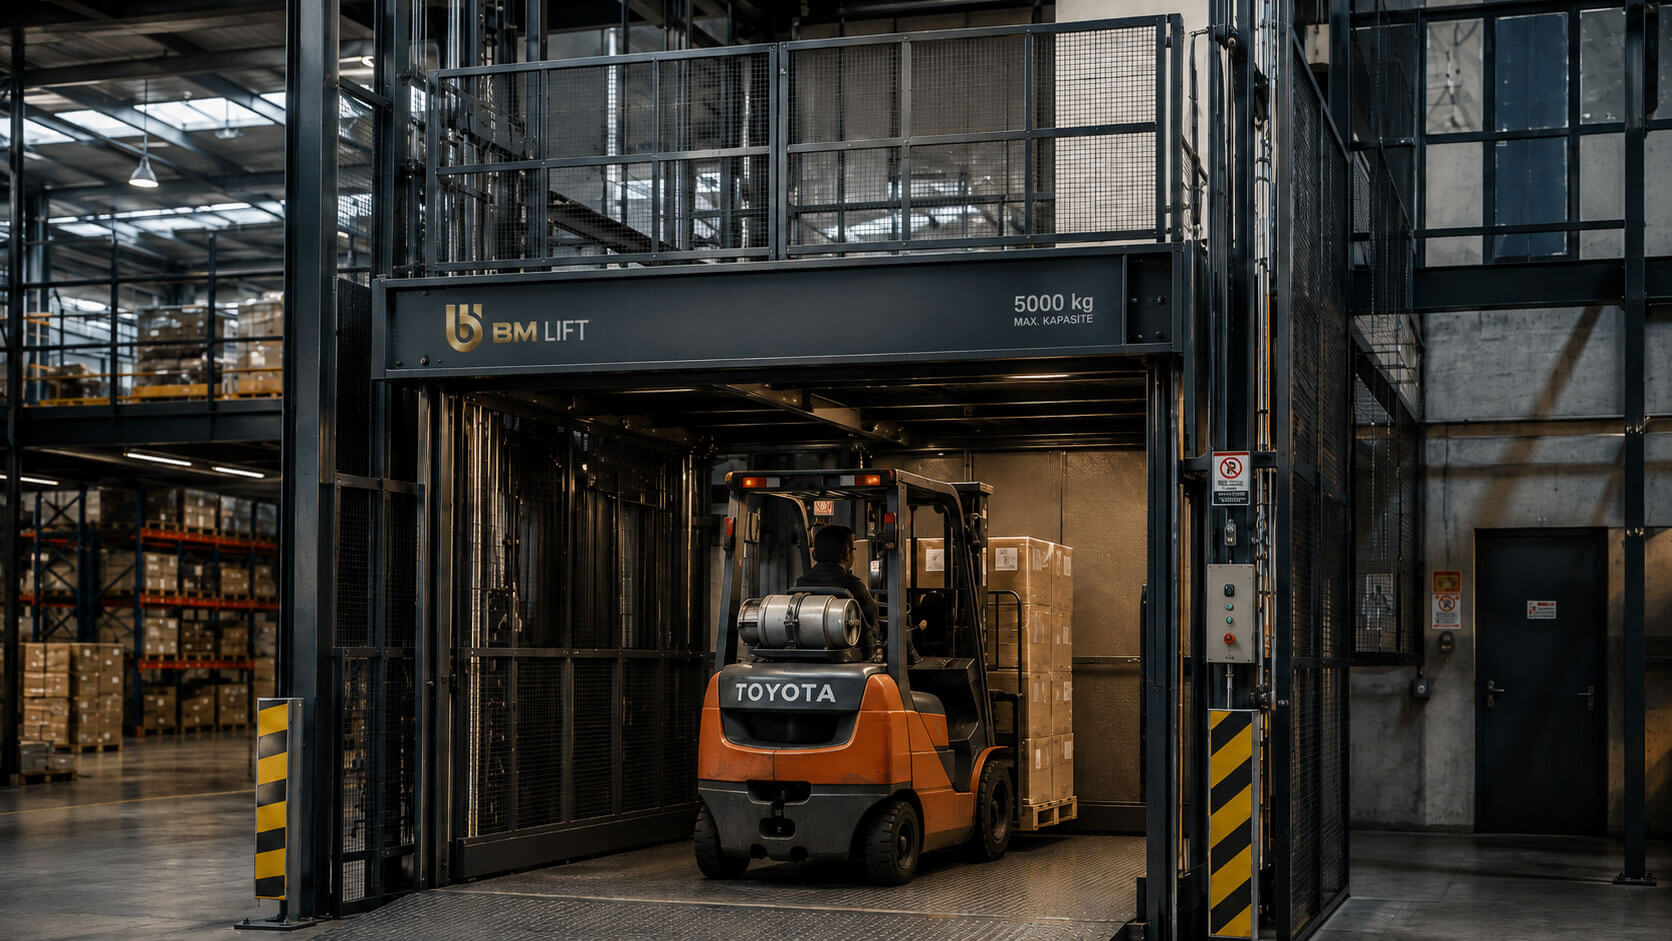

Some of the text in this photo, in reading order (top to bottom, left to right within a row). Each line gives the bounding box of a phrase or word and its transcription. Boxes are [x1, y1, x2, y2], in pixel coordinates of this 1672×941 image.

[1014, 293, 1094, 313] 5000 kg
[1014, 314, 1094, 327] MAX. KAPASITE
[492, 319, 589, 344] BM LIFT
[735, 682, 836, 703] TOYOTA
